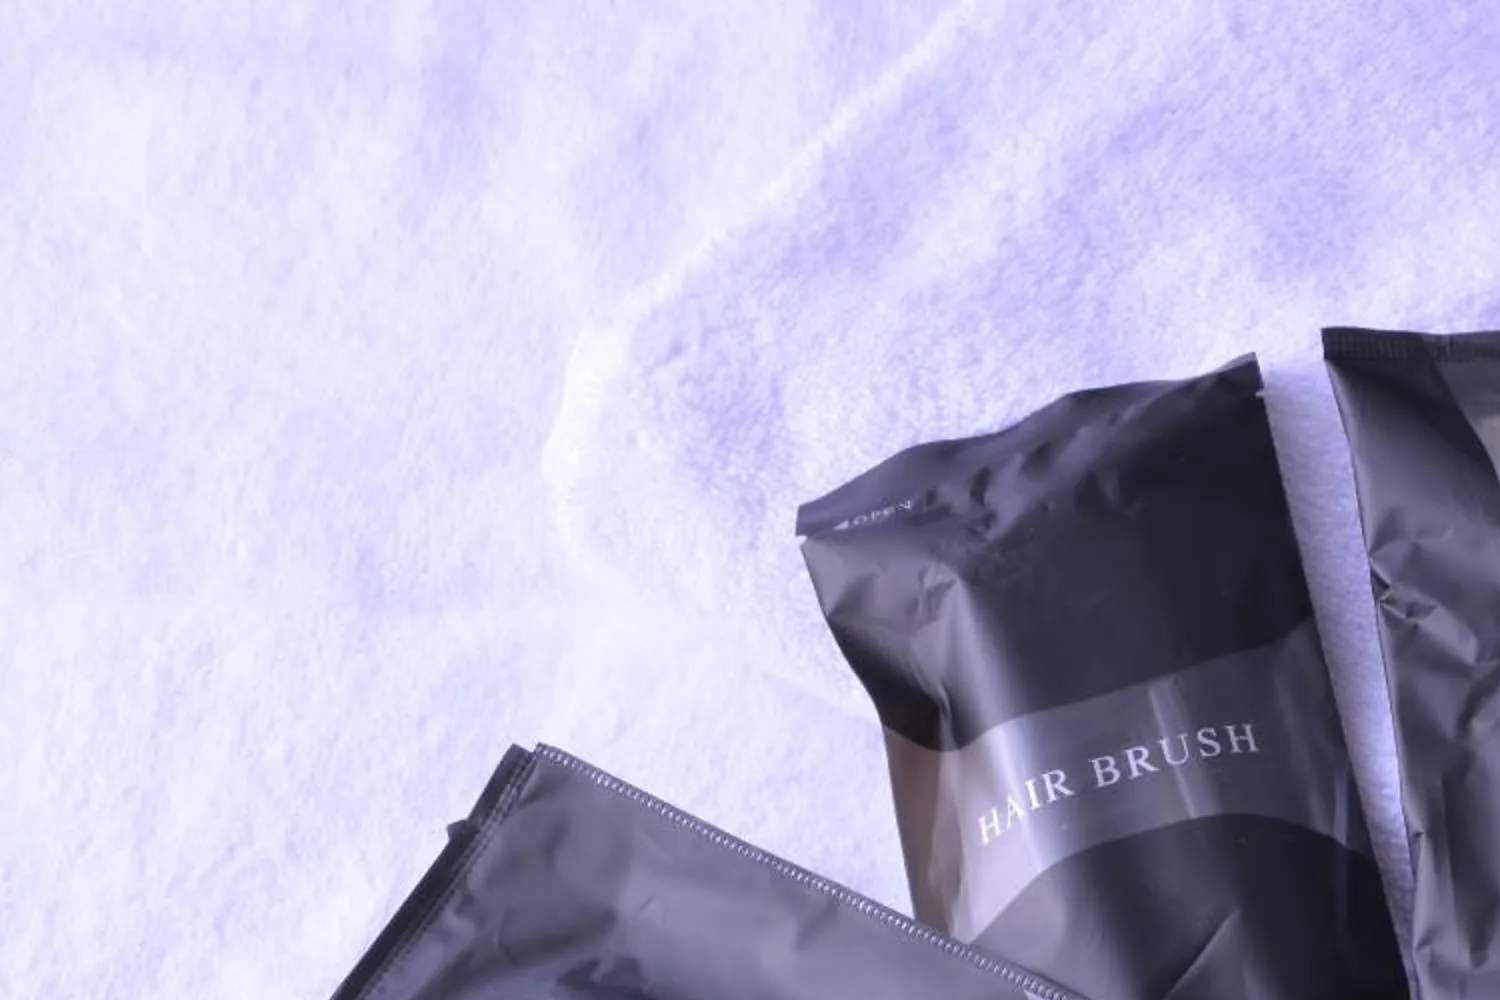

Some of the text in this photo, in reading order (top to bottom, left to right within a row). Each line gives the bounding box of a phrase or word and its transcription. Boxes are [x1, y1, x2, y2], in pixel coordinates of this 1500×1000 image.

[853, 499, 912, 526] OPEN
[977, 723, 1260, 846] HAIR BRUSH
